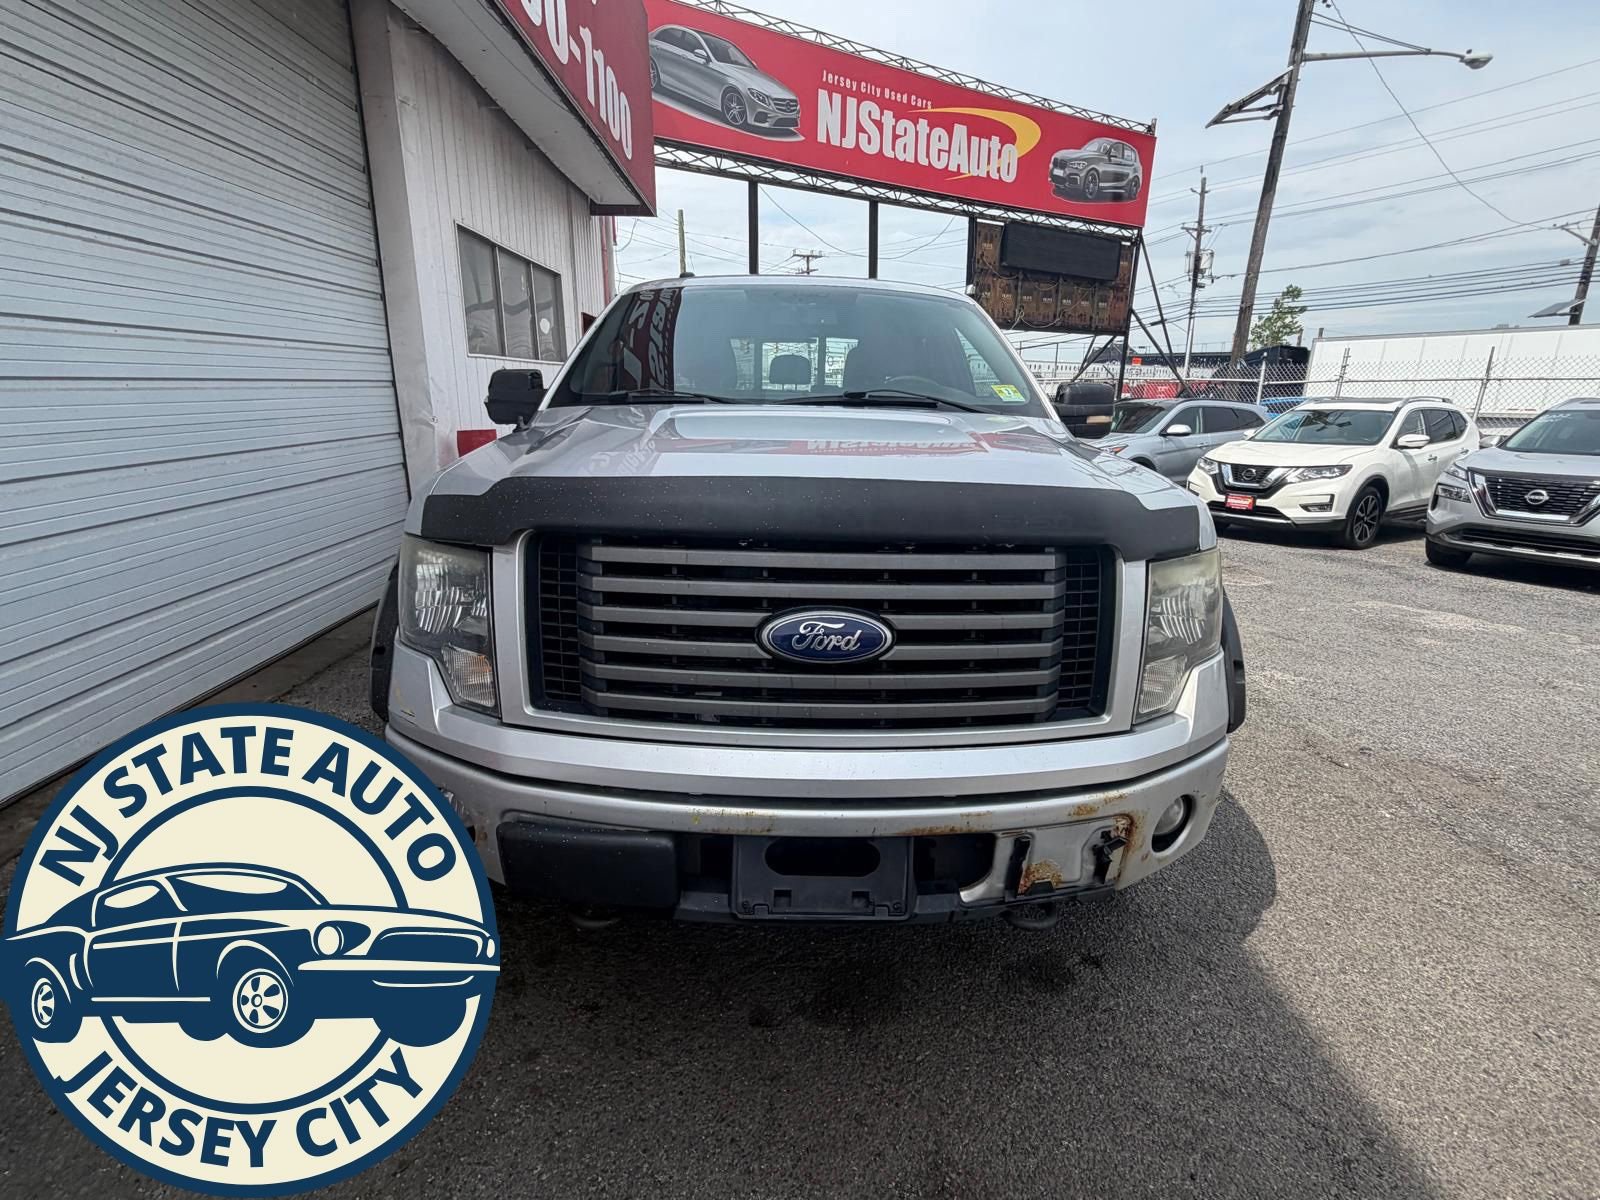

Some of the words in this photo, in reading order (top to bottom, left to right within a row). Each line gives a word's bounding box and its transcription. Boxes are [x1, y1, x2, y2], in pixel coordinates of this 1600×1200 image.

[520, 0, 632, 160] 0-1100
[822, 69, 857, 91] Jersey
[860, 81, 881, 98] City
[884, 87, 908, 103] Used
[910, 94, 932, 110] Cars
[817, 88, 1018, 183] NJStateAuto
[791, 620, 862, 651] Ford
